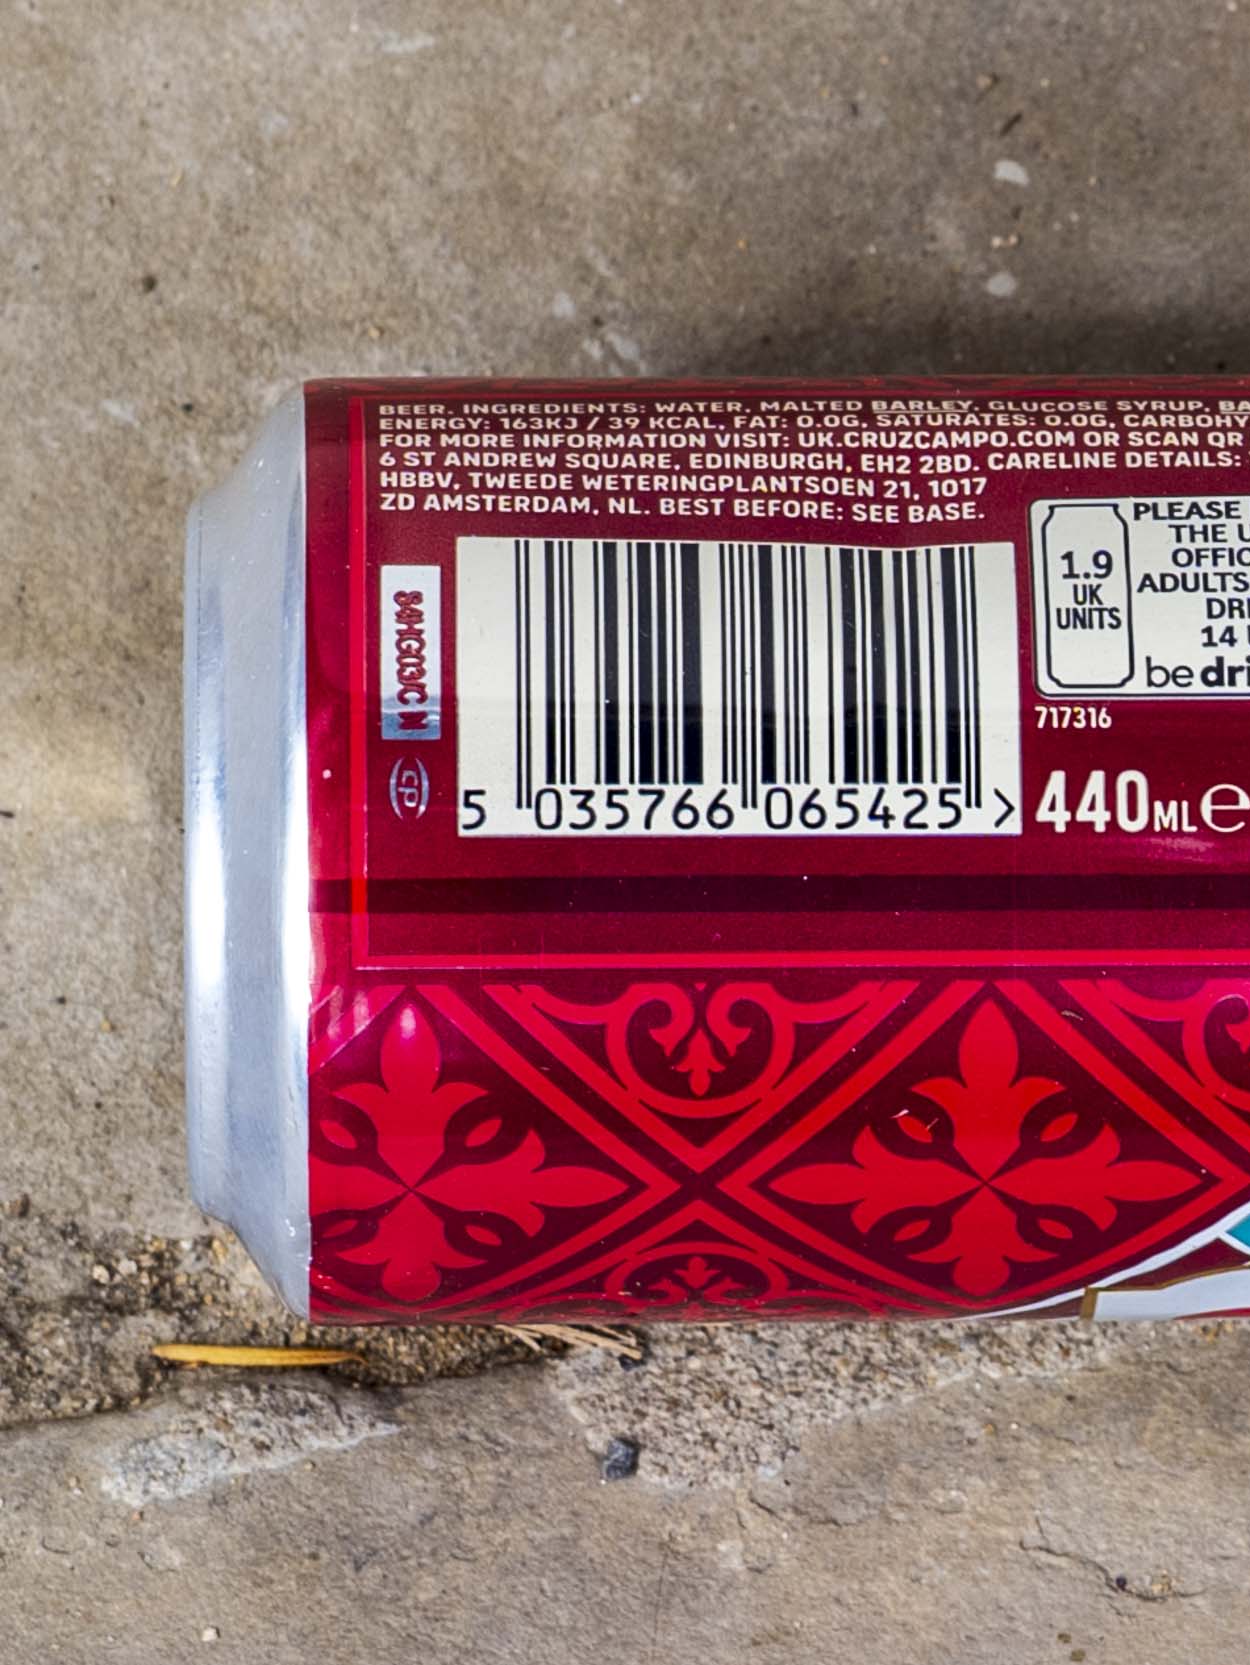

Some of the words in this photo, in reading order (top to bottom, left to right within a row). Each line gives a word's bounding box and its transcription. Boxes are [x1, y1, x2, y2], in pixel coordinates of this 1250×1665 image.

[462, 403, 645, 414] INGREDIENTS:
[759, 400, 863, 412] MALTED
[987, 400, 1108, 413] GLUCOSE
[379, 417, 489, 430] ENERGY:
[499, 417, 578, 430] 163KJ
[586, 416, 599, 431] /
[608, 416, 640, 430] 39
[733, 415, 787, 429] FAT:
[875, 413, 1036, 427] SATURATES:
[379, 433, 431, 447] FOR
[439, 433, 515, 448] MORE
[522, 433, 706, 448] INFORMATION
[713, 432, 789, 448] VISIT:
[797, 430, 1075, 449] UK.CRUZCAMPO.COM
[1082, 431, 1120, 447] OR
[1127, 431, 1199, 447] SCAN
[1206, 431, 1243, 448] QR
[378, 451, 396, 467] 6
[402, 451, 436, 467] ST
[443, 452, 556, 468] ANDREW
[564, 453, 680, 470] SQUARE,
[688, 453, 852, 471] EDINBURGH,
[860, 454, 911, 474] EH2
[918, 454, 979, 474] 2BD.
[987, 452, 1117, 470] CARELINE
[1124, 451, 1241, 468] DETAILS:
[379, 471, 460, 489] HBBV,
[467, 472, 573, 490] TWEEDE
[581, 474, 874, 496] WETERINGPLANTSOEN
[882, 480, 919, 501] 21,
[927, 477, 987, 497] 1017
[379, 492, 415, 511] ZD
[422, 494, 599, 514] AMSTERDAM,
[607, 497, 650, 515] NL.
[659, 498, 725, 516] BEST
[733, 499, 843, 520] BEFORE:
[851, 503, 899, 523] SEE
[907, 501, 985, 523] BASE.
[1133, 500, 1242, 521] PLEASE
[1169, 523, 1228, 544] THE
[1060, 549, 1113, 580] 1.9
[1136, 571, 1250, 594] ADULTS
[1072, 583, 1104, 606] UK
[1056, 606, 1122, 630] UNITS
[1201, 625, 1238, 648] 14
[1034, 705, 1112, 729] 717316
[460, 789, 488, 831] 5
[534, 786, 735, 831] 035766
[764, 786, 962, 830] 065425
